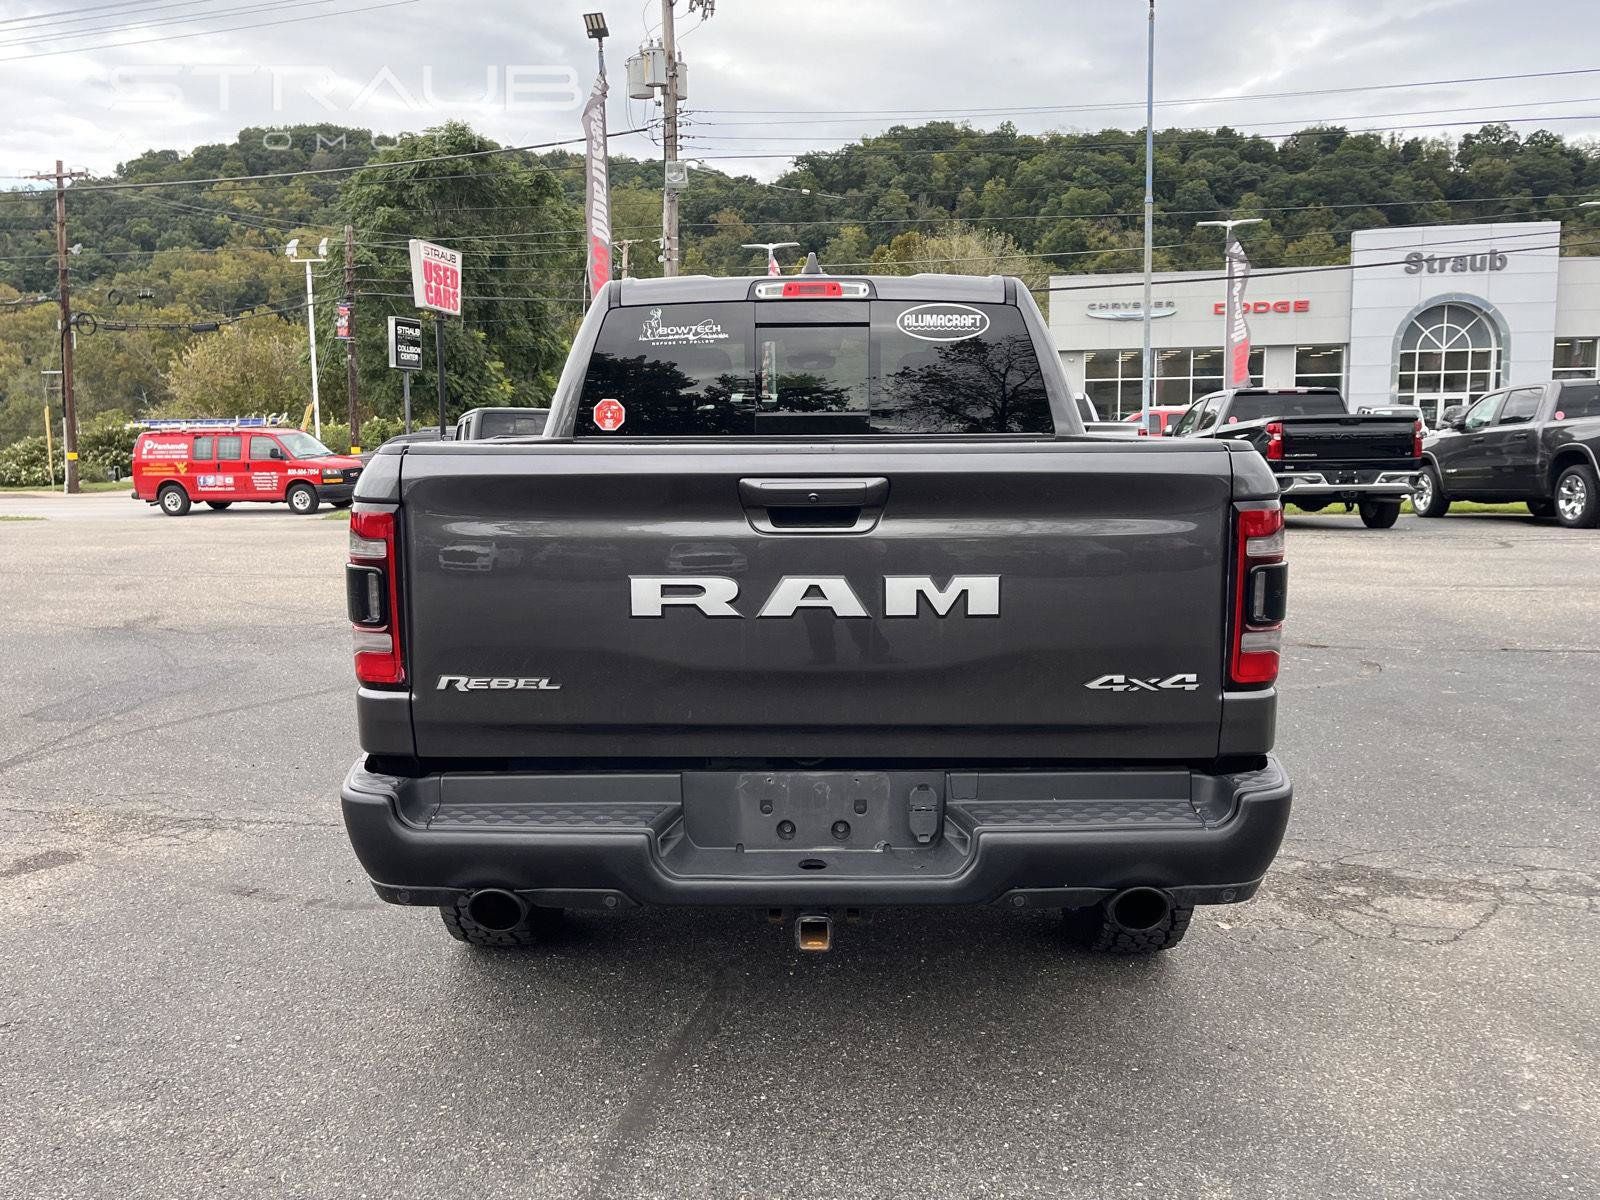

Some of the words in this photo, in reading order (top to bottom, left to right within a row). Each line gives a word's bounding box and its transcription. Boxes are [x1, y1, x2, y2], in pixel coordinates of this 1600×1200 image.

[423, 246, 457, 263] STRAUB
[1404, 250, 1508, 275] Straub
[424, 261, 458, 290] USED
[425, 284, 458, 312] CARS
[904, 314, 982, 327] ALUMACRAFT
[397, 326, 420, 335] STRAUB
[660, 325, 721, 334] BOWTECH
[397, 345, 421, 353] COLLISION
[400, 353, 418, 362] CENTER
[629, 574, 1001, 619] RAM
[436, 674, 562, 692] REBEL
[1084, 673, 1200, 692] 4x4
